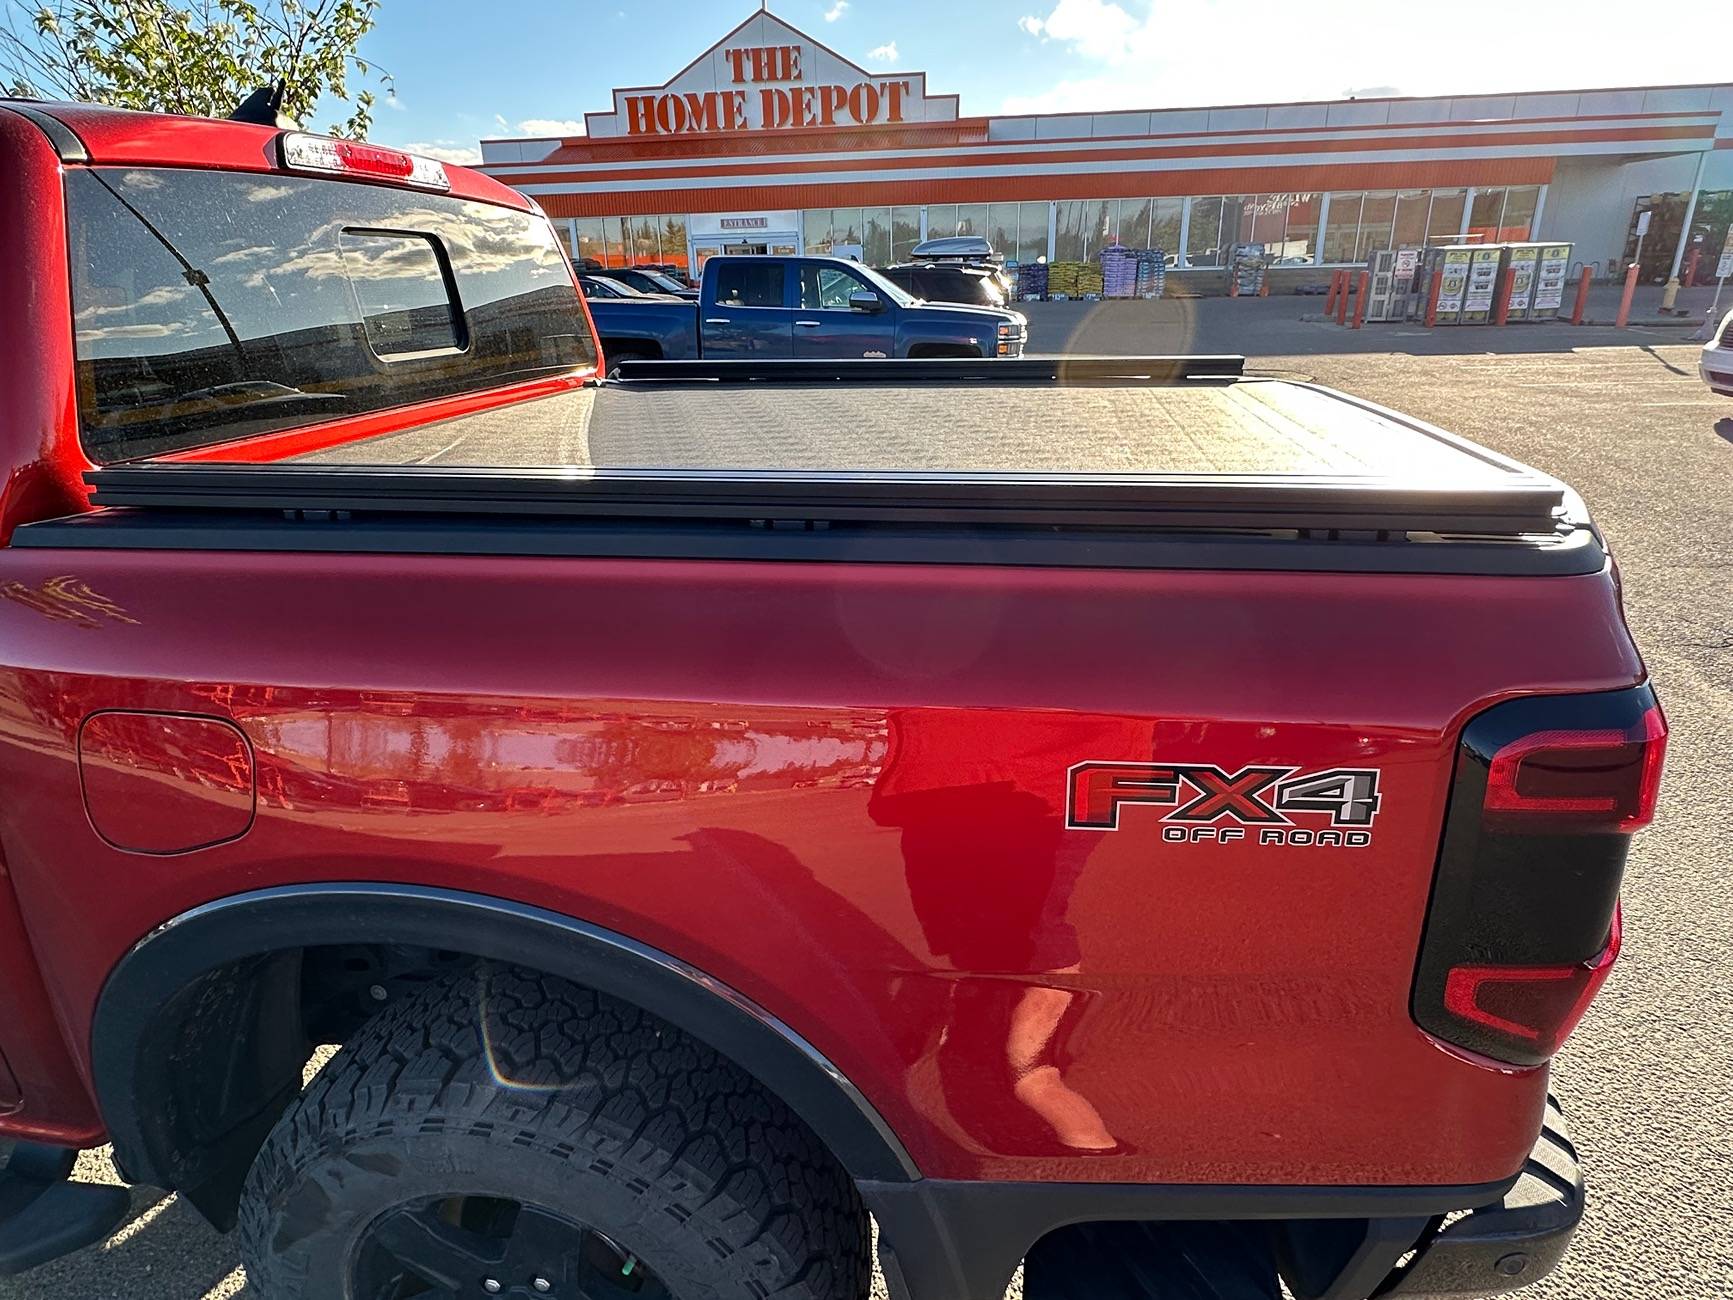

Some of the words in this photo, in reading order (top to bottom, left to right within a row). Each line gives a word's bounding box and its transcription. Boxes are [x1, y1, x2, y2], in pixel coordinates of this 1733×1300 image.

[725, 45, 803, 84] THE
[624, 89, 748, 135] HOME
[760, 80, 910, 129] DEPOT
[1065, 760, 1382, 831] FX4
[1161, 826, 1245, 844] OFF
[1259, 828, 1371, 847] ROAD
